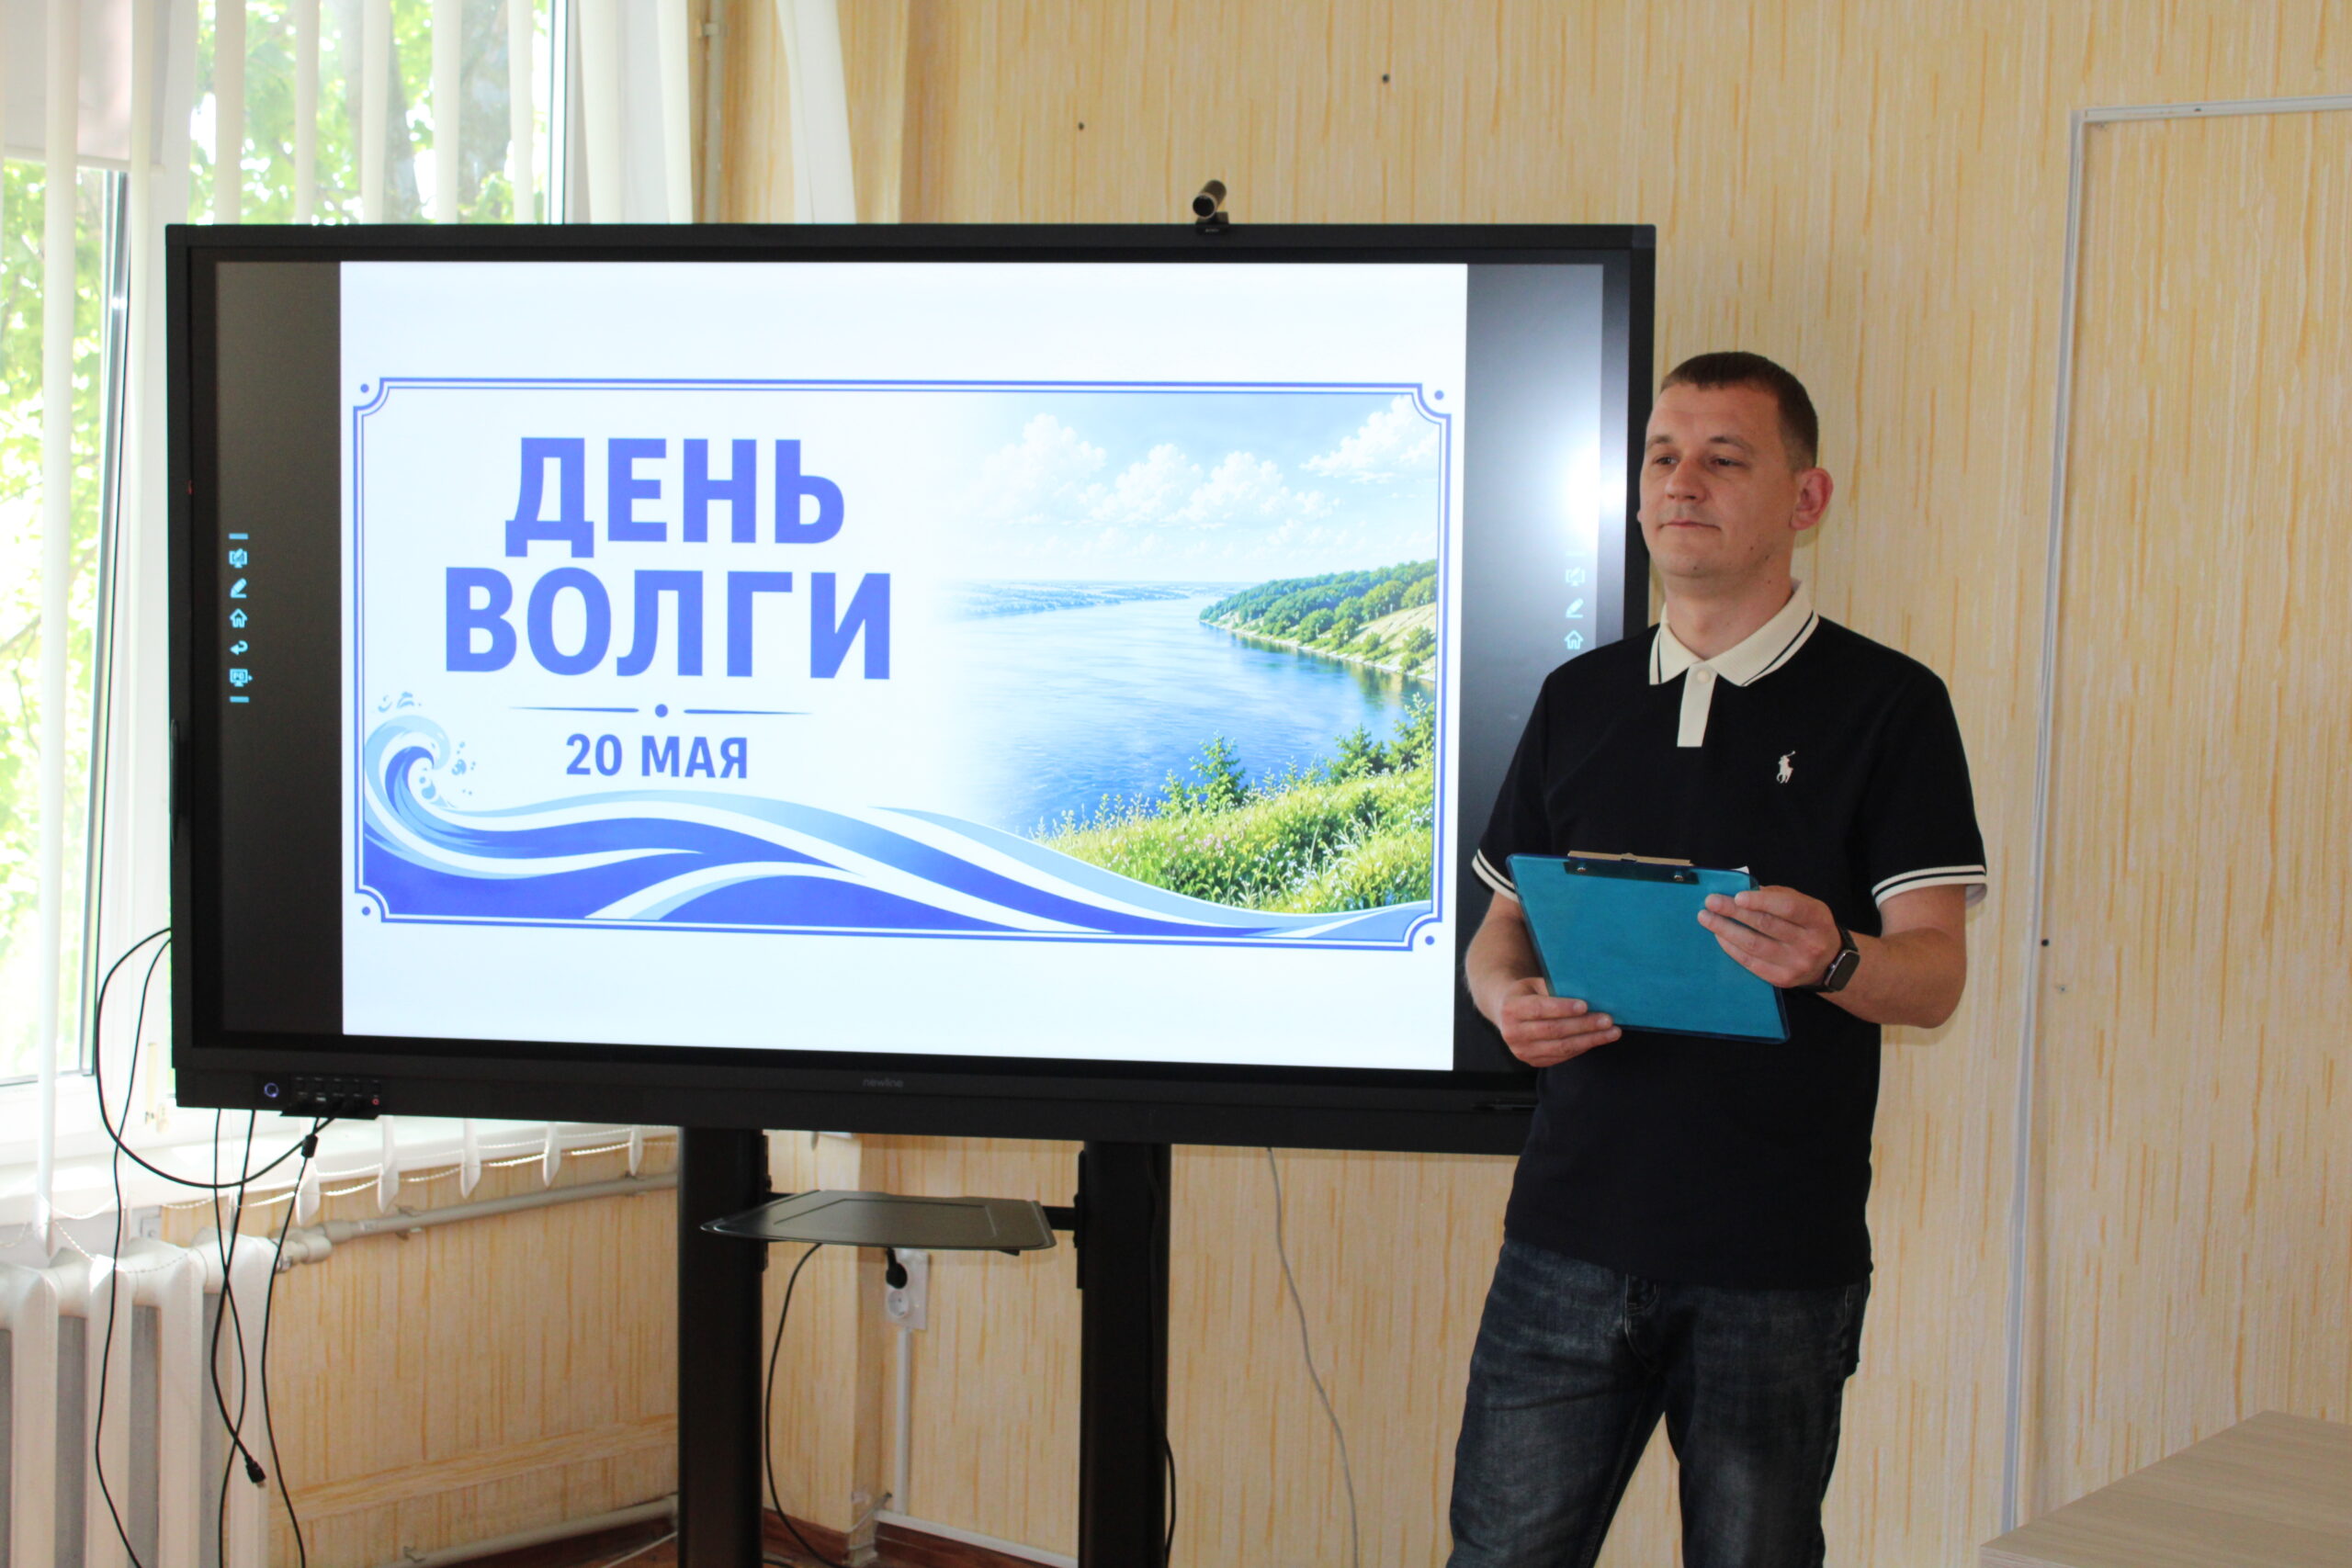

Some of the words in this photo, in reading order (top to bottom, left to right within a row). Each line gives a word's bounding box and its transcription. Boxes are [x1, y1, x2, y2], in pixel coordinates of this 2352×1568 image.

[505, 436, 844, 558] ДЕНЬ
[446, 566, 891, 680] ВОЛГИ
[566, 733, 623, 777] 20
[641, 735, 748, 779] МАЯ
